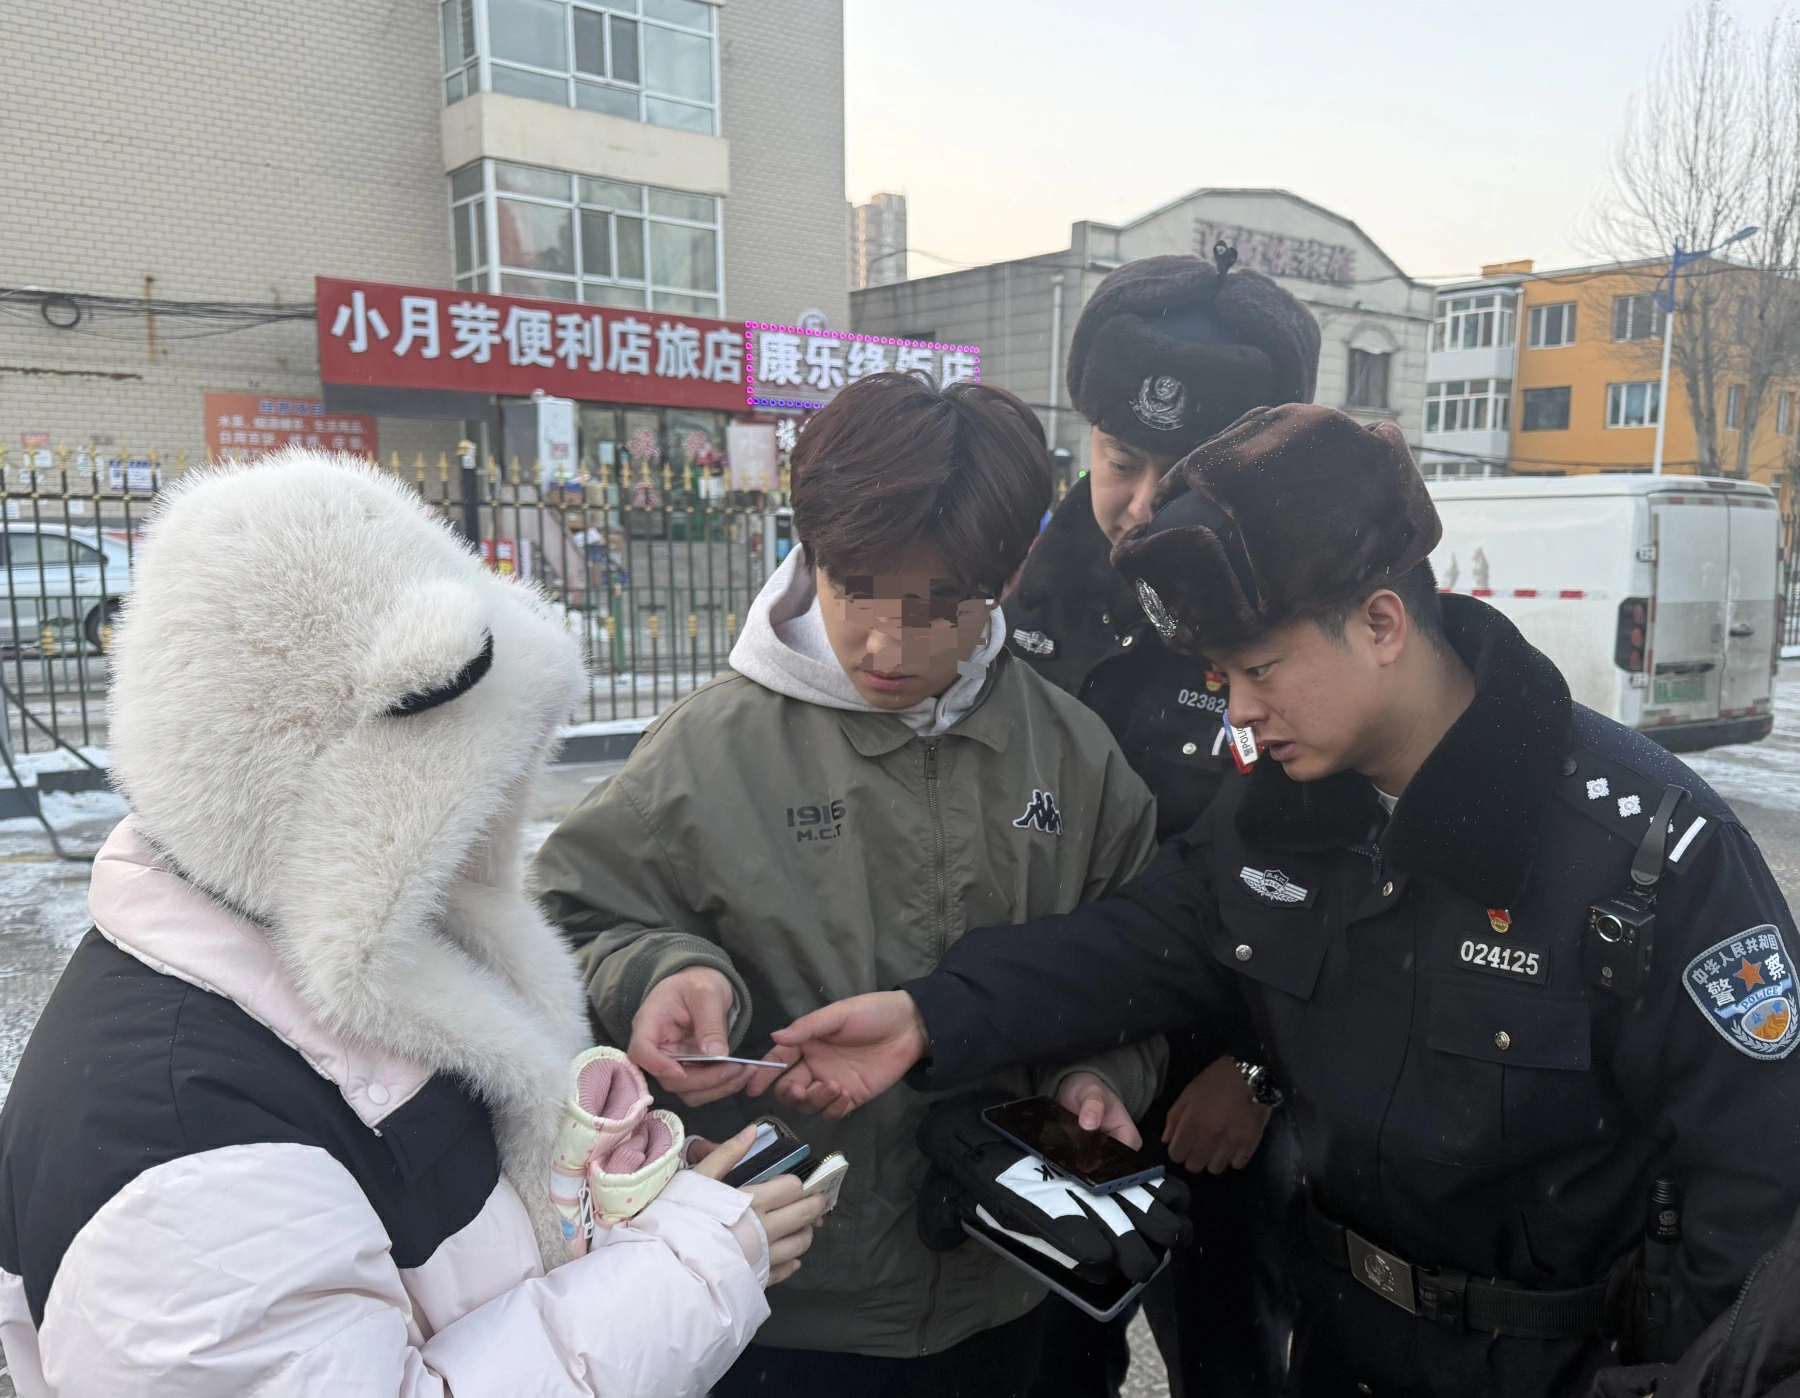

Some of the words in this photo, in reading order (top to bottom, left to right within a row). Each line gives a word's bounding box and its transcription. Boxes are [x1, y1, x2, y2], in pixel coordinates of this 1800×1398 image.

[331, 290, 742, 384] 小月芽便利店旅店
[787, 799, 846, 828] 1916
[1459, 940, 1540, 976] 024125
[1691, 933, 1779, 985] 中华人民共和国
[1740, 986, 1779, 1010] POLICE
